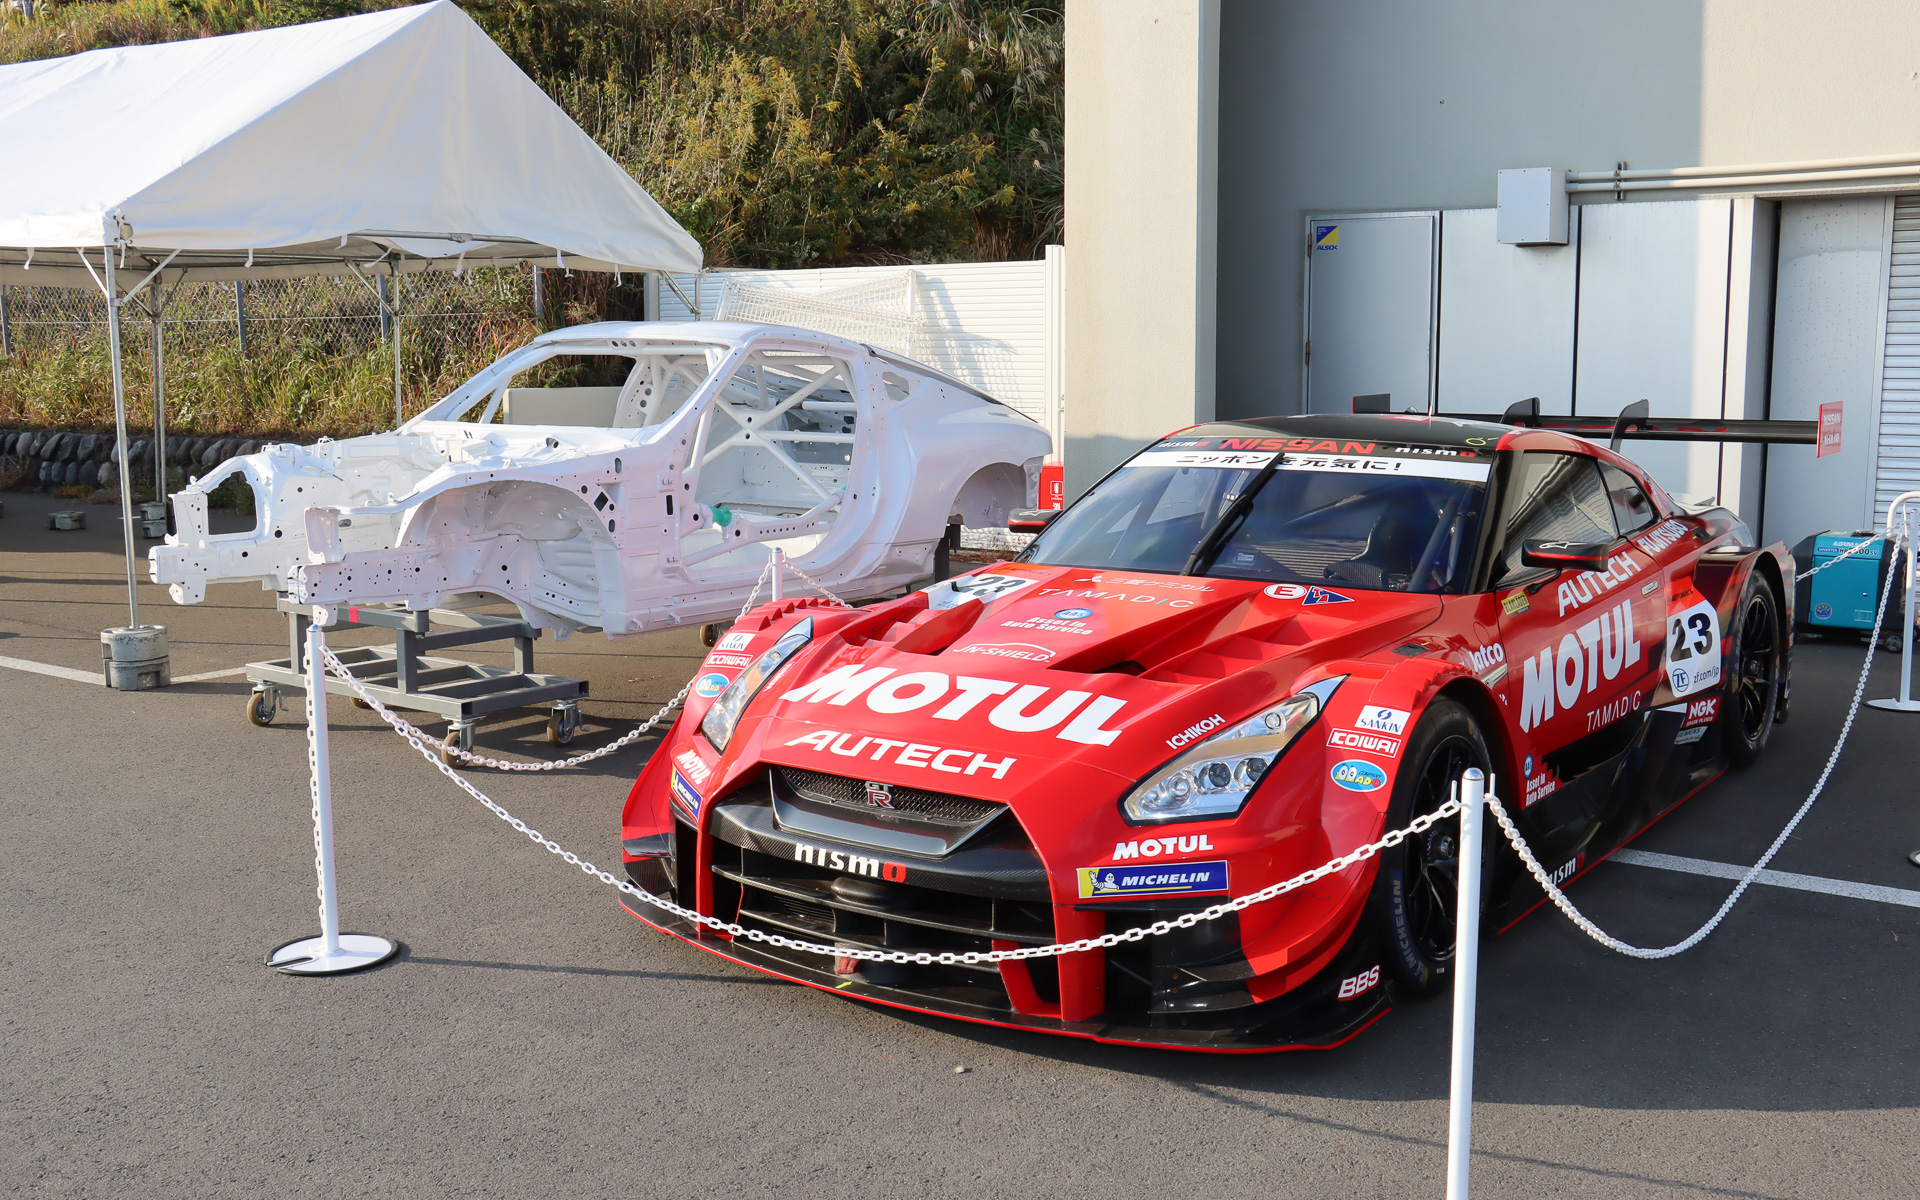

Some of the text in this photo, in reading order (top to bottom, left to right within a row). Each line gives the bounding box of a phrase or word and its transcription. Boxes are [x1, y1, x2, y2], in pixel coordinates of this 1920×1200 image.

[1218, 438, 1377, 455] NISSAN
[1395, 447, 1475, 458] nismo
[1637, 519, 1689, 556] FUJITSUBO
[1832, 540, 1861, 548] AIRMA
[1038, 588, 1194, 608] TAMADIC
[1558, 551, 1642, 618] AUTECH
[1000, 620, 1093, 635] Auto Service
[1026, 616, 1087, 628] Asset in
[1670, 612, 1713, 663] 23
[1519, 598, 1642, 734] MOTUL
[1693, 665, 1720, 685] zf.com/jp
[777, 663, 1129, 747] MOTUL
[1587, 690, 1641, 732] TAMADIC
[1688, 698, 1717, 720] NGK
[1165, 713, 1225, 750] ICHIKOH
[1359, 717, 1402, 733] SANKIN
[784, 729, 1018, 780] AUTECH
[1331, 731, 1398, 754] KOIWAI
[677, 748, 711, 785] MOTUL
[678, 782, 699, 810] MICHELIN
[1525, 780, 1556, 807] Auto Service
[1526, 772, 1546, 794] Asset in
[1112, 835, 1214, 861] MOTUL
[793, 842, 907, 883] nismo
[1121, 870, 1211, 887] MICHELIN
[1392, 879, 1418, 969] MICHELIN
[1338, 964, 1380, 999] BBS
